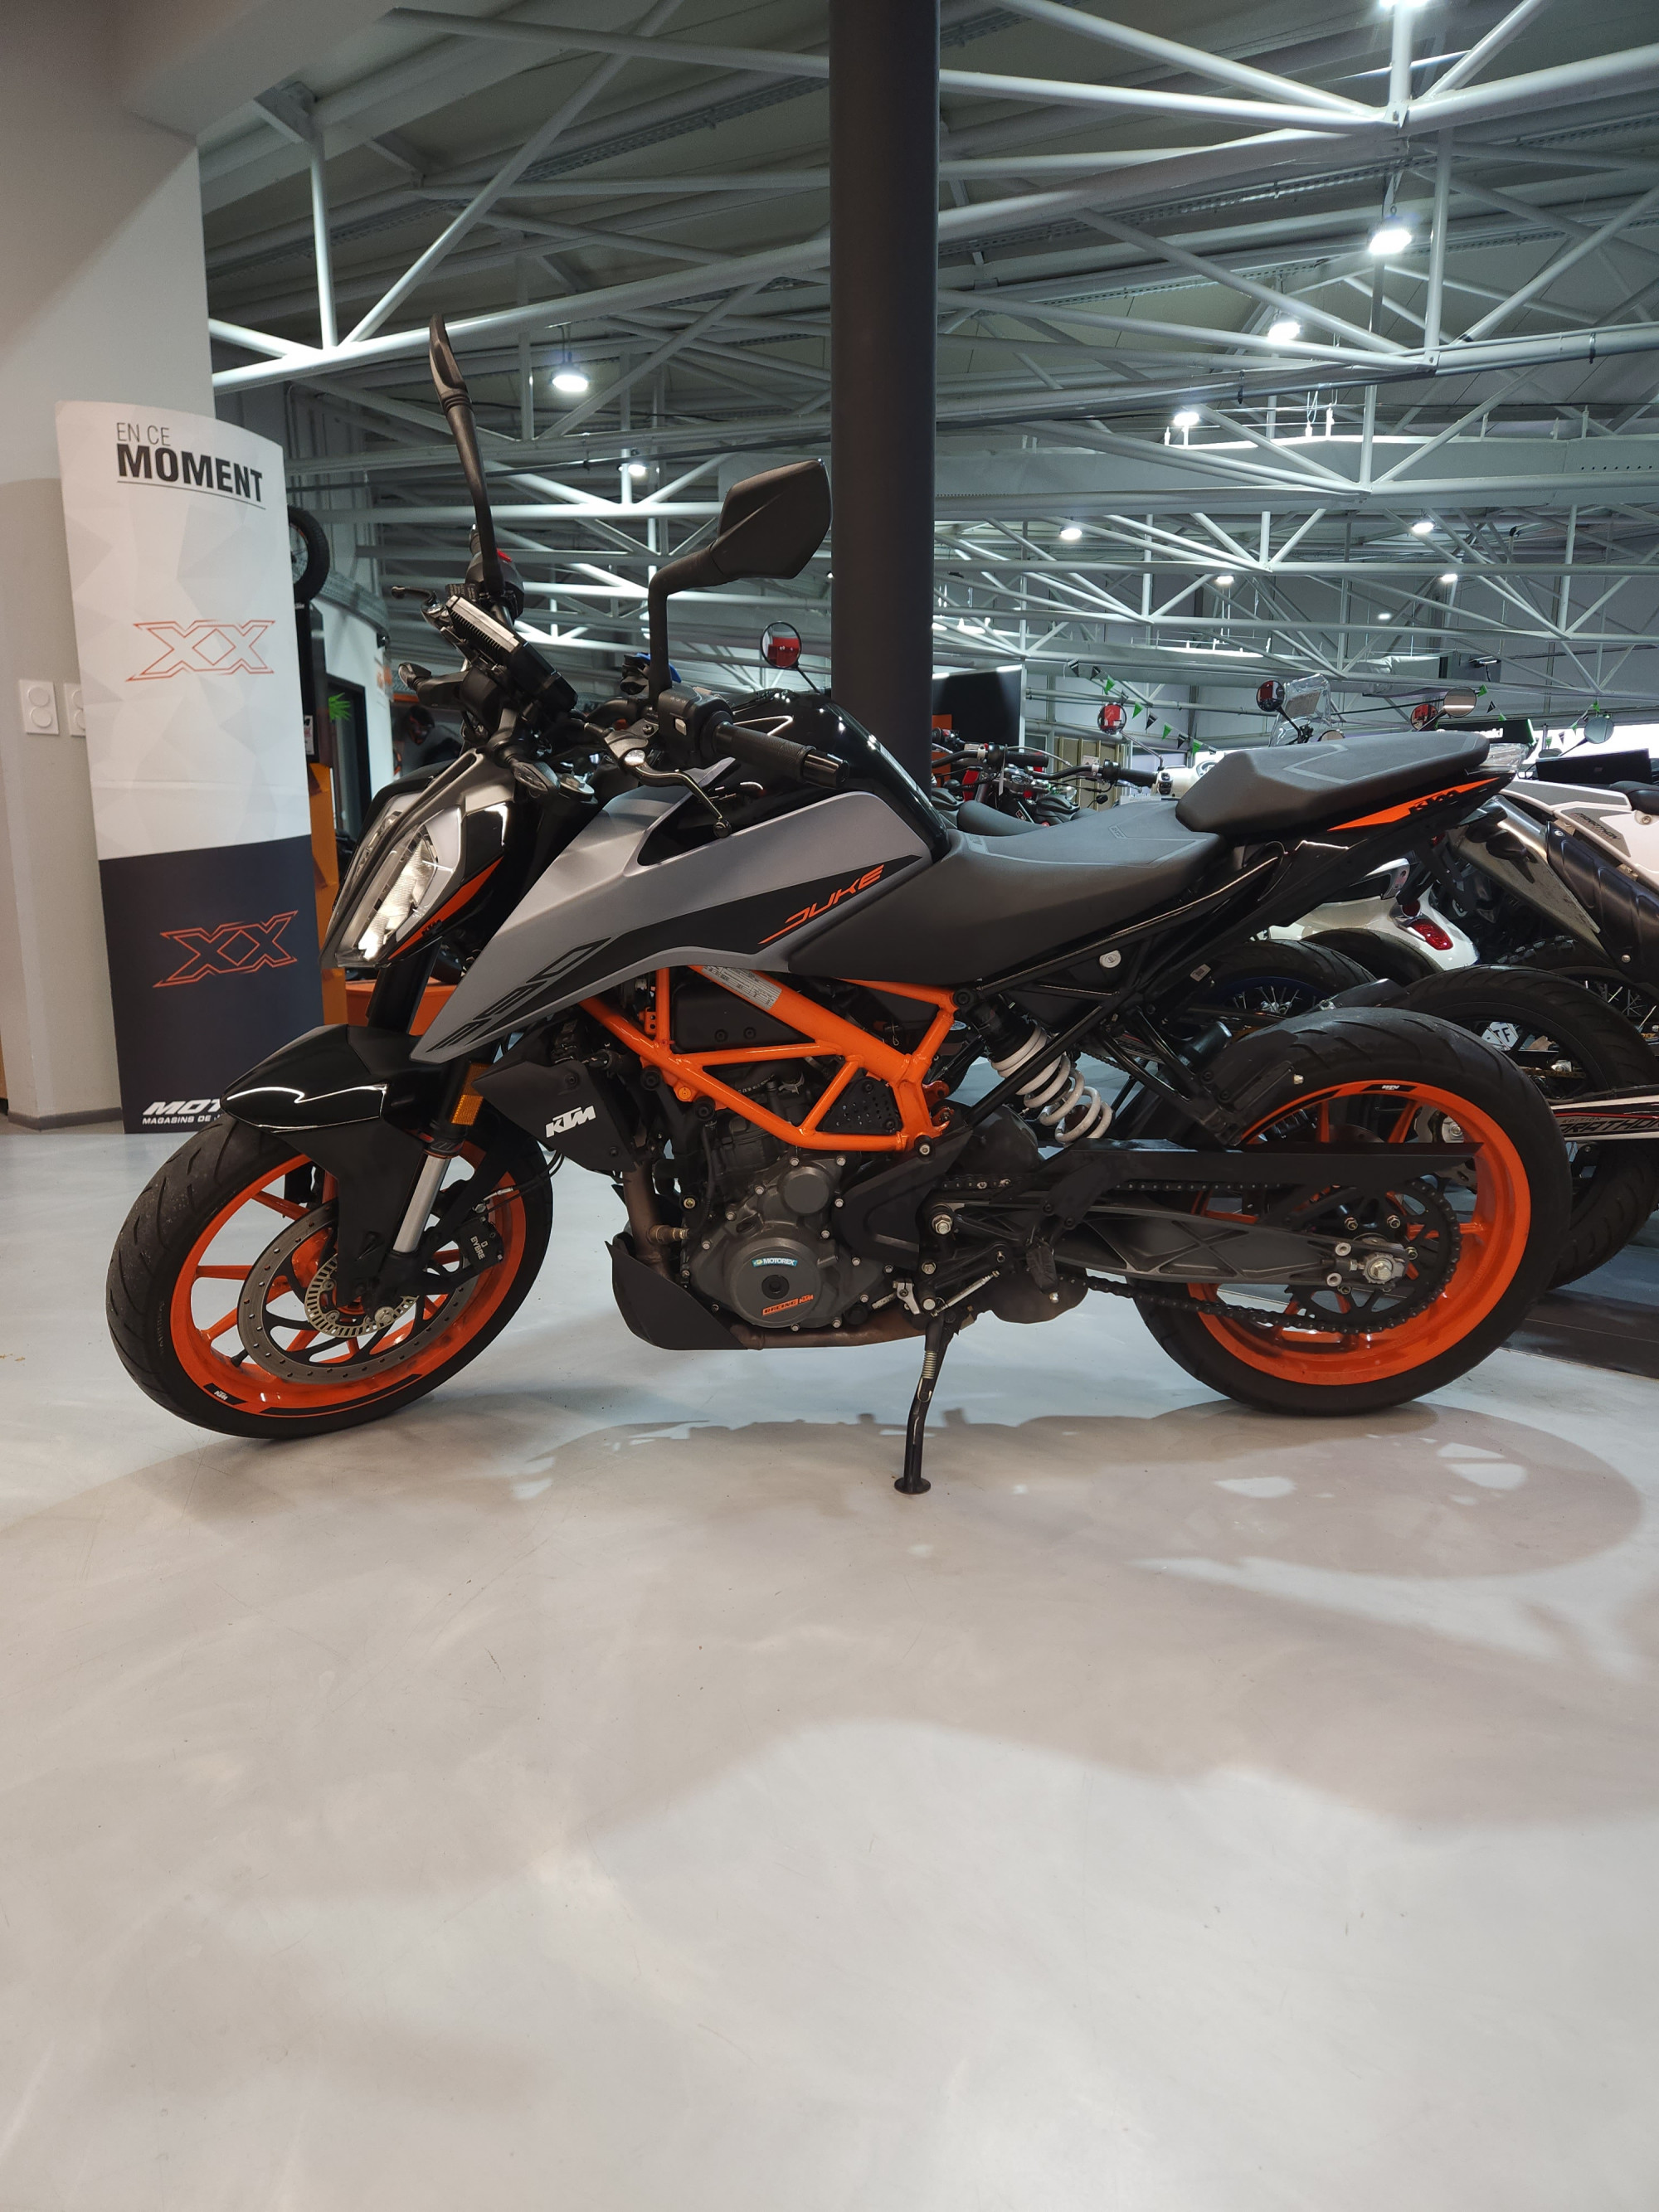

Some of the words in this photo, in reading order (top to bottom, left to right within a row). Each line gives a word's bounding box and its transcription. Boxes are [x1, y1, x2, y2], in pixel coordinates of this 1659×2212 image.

[117, 422, 139, 442] EN
[147, 425, 171, 446] CE
[116, 444, 263, 502] MOMENT
[757, 864, 884, 944] DUKE
[143, 1099, 221, 1116] MOT
[142, 1116, 195, 1125] MAGASINS
[545, 1105, 596, 1138] KTM
[470, 1236, 485, 1260] BYBRE
[763, 1257, 795, 1266] MOTOREX
